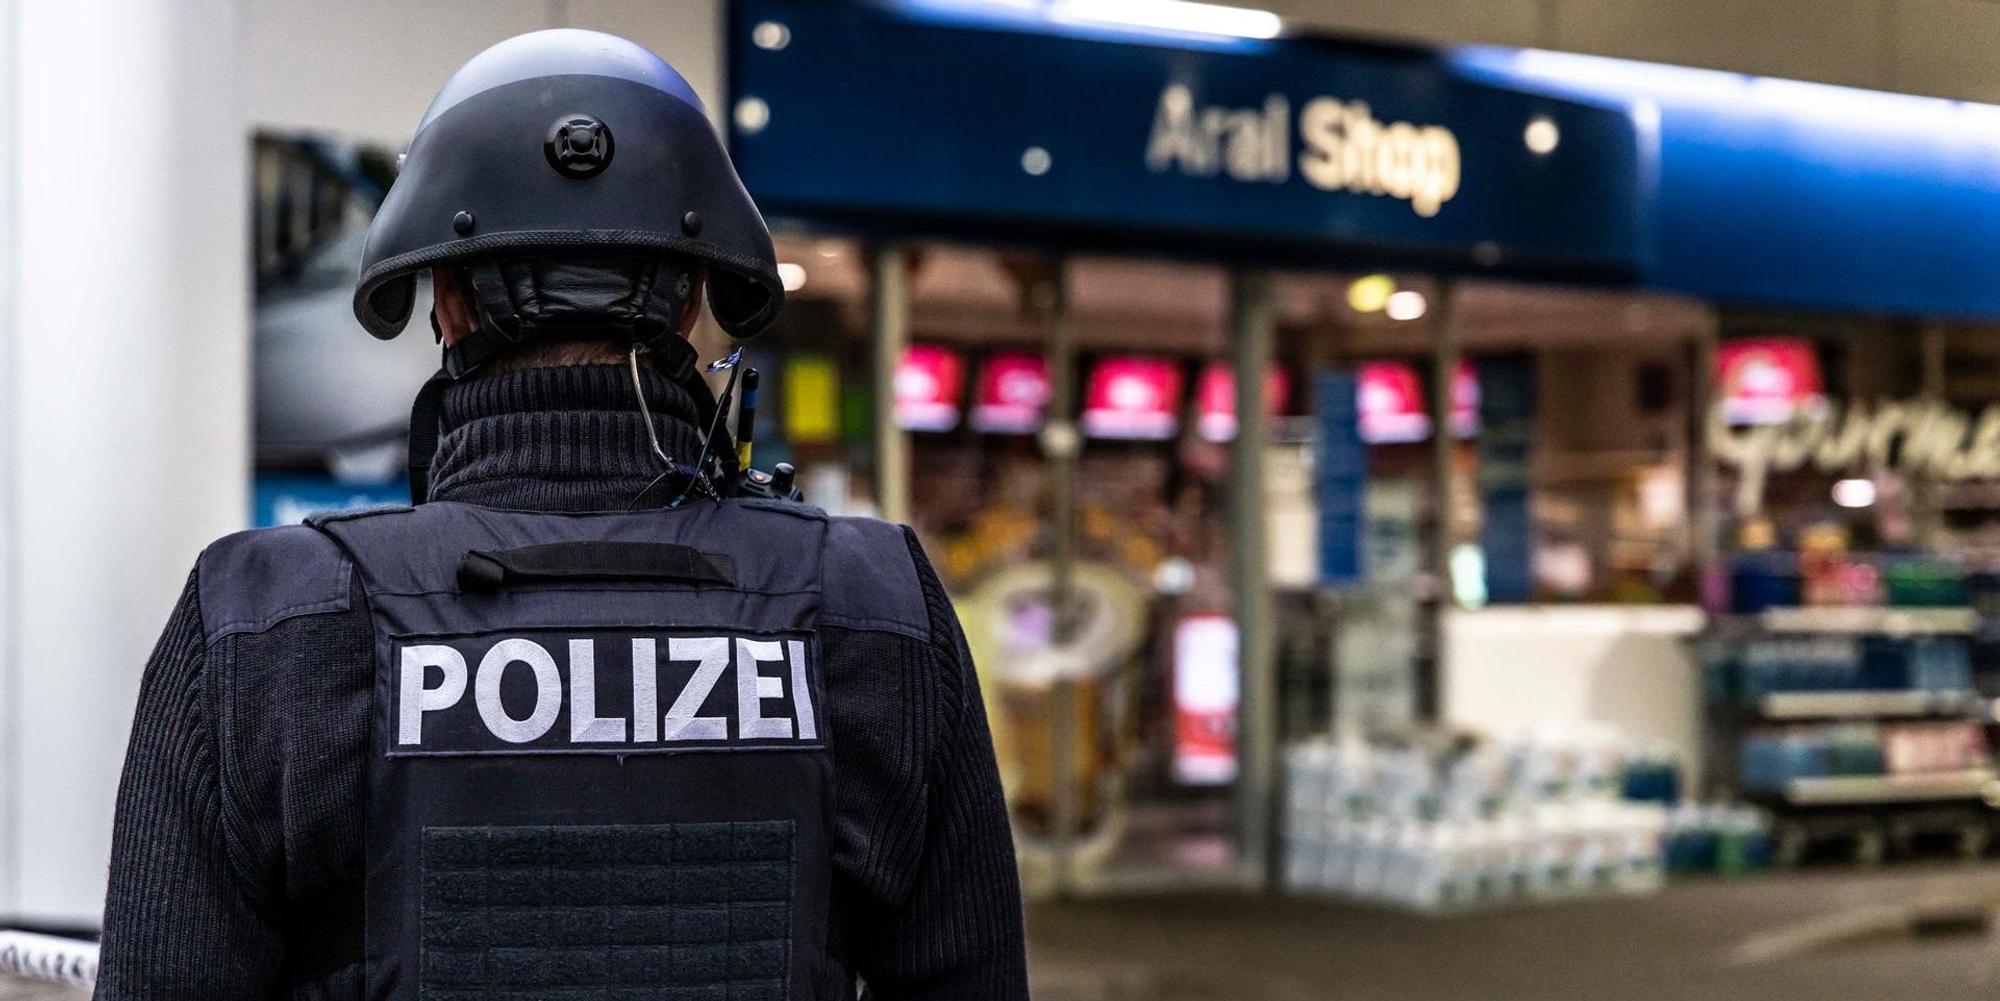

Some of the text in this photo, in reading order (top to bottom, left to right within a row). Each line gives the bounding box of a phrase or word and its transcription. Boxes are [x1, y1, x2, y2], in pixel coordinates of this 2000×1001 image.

[1146, 85, 1459, 216] Aral Shop
[398, 636, 817, 745] POLIZEI
